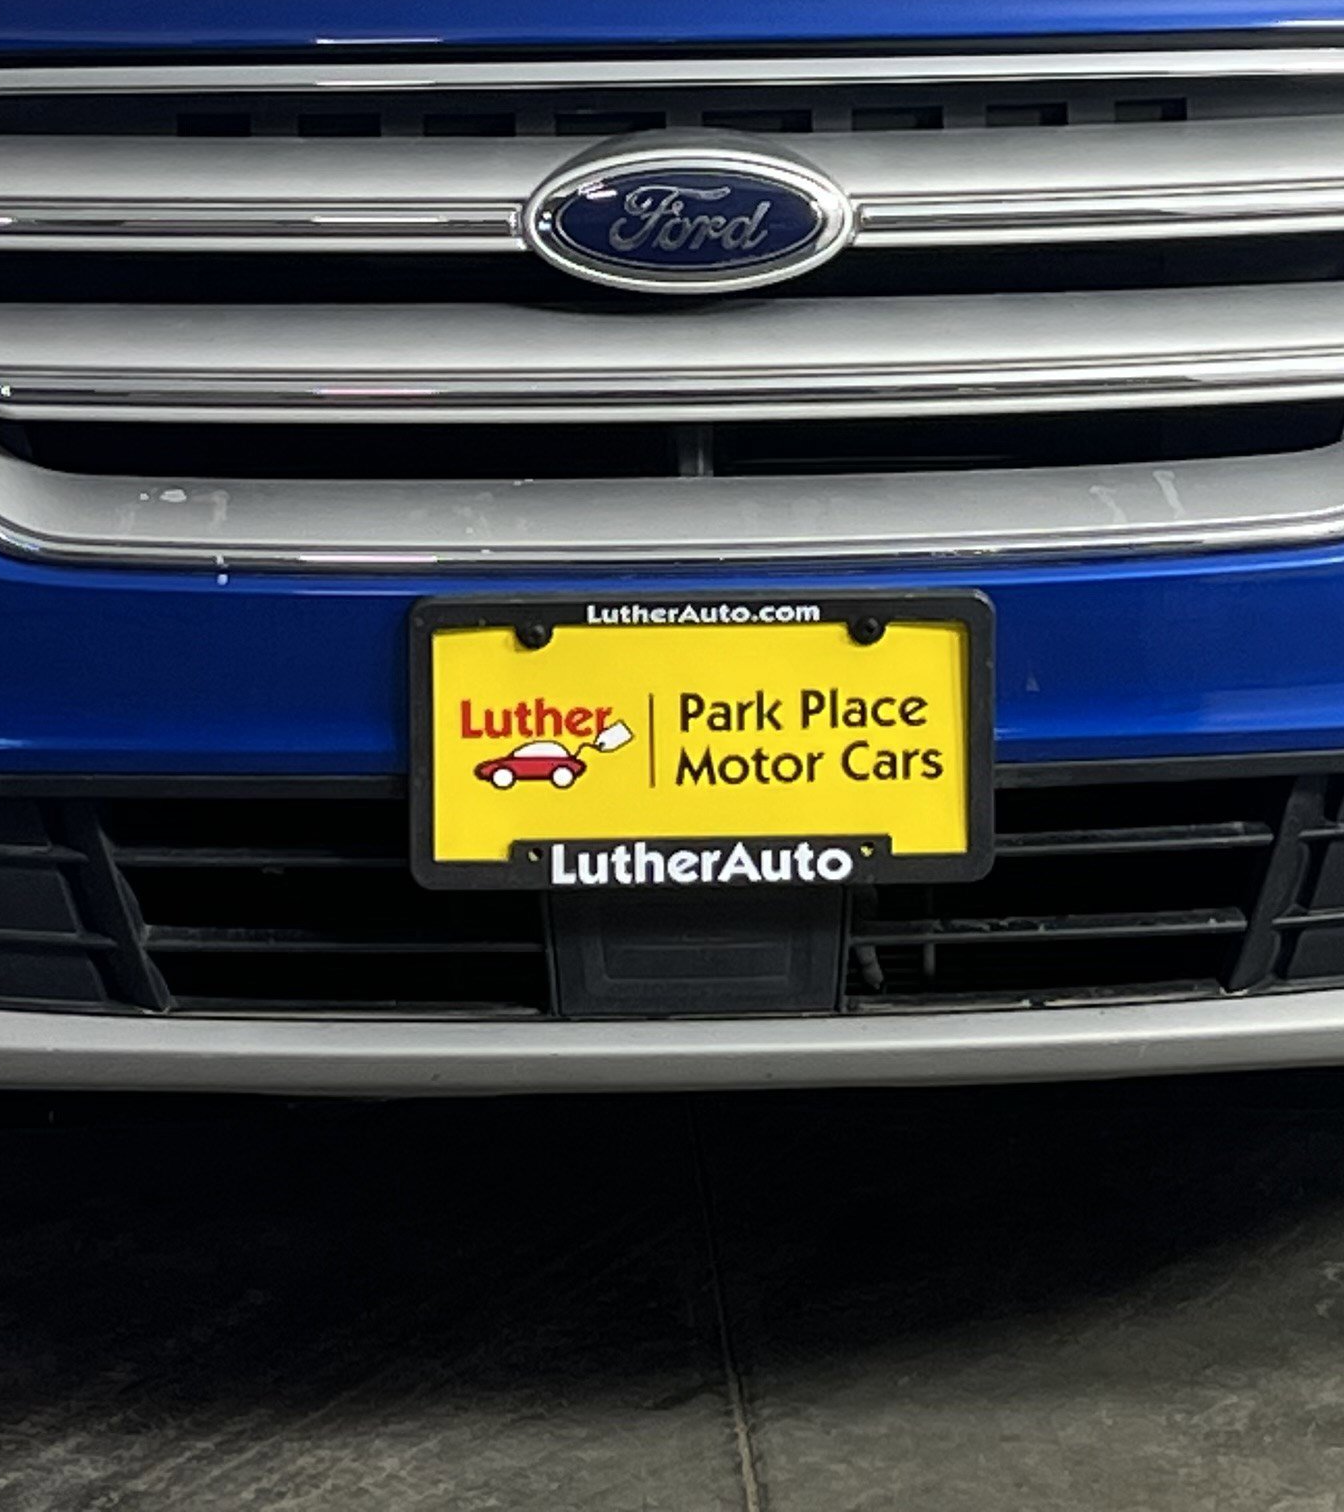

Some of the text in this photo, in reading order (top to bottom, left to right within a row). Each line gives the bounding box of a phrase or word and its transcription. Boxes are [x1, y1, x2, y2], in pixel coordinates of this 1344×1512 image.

[608, 185, 771, 251] Ford
[587, 603, 821, 624] LutherAuto.com
[460, 698, 613, 739] Luther
[679, 688, 928, 732] Park Place
[675, 739, 944, 787] Motor Cars
[550, 842, 854, 885] LutherAuto
